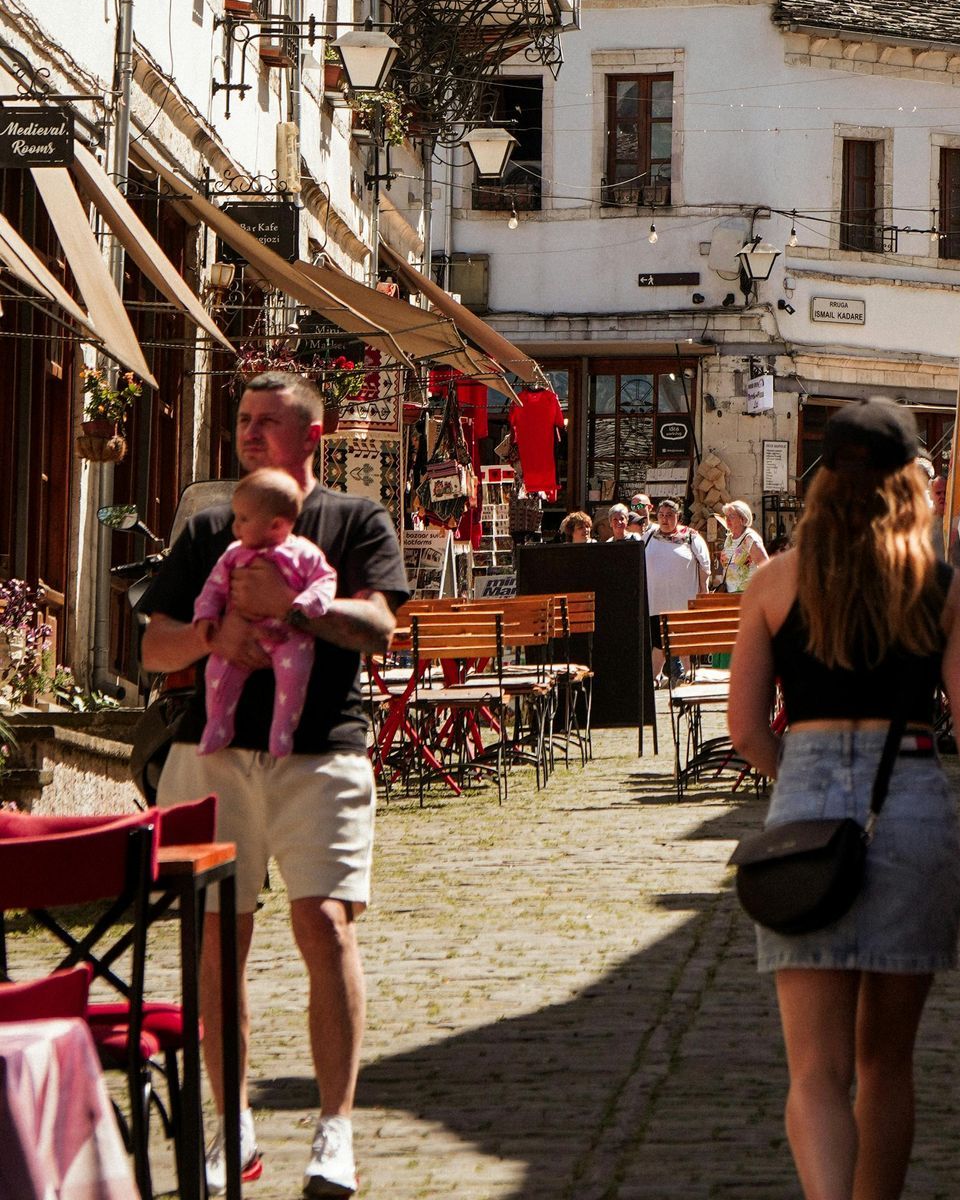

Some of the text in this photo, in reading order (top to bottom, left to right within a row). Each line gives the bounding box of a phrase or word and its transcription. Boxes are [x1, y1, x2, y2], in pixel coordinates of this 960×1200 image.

[0, 122, 66, 136] Medieval
[11, 140, 56, 157] Rooms
[258, 222, 279, 232] Kafe
[815, 311, 863, 320] ISMAIL KADARE
[315, 326, 340, 334] Mini
